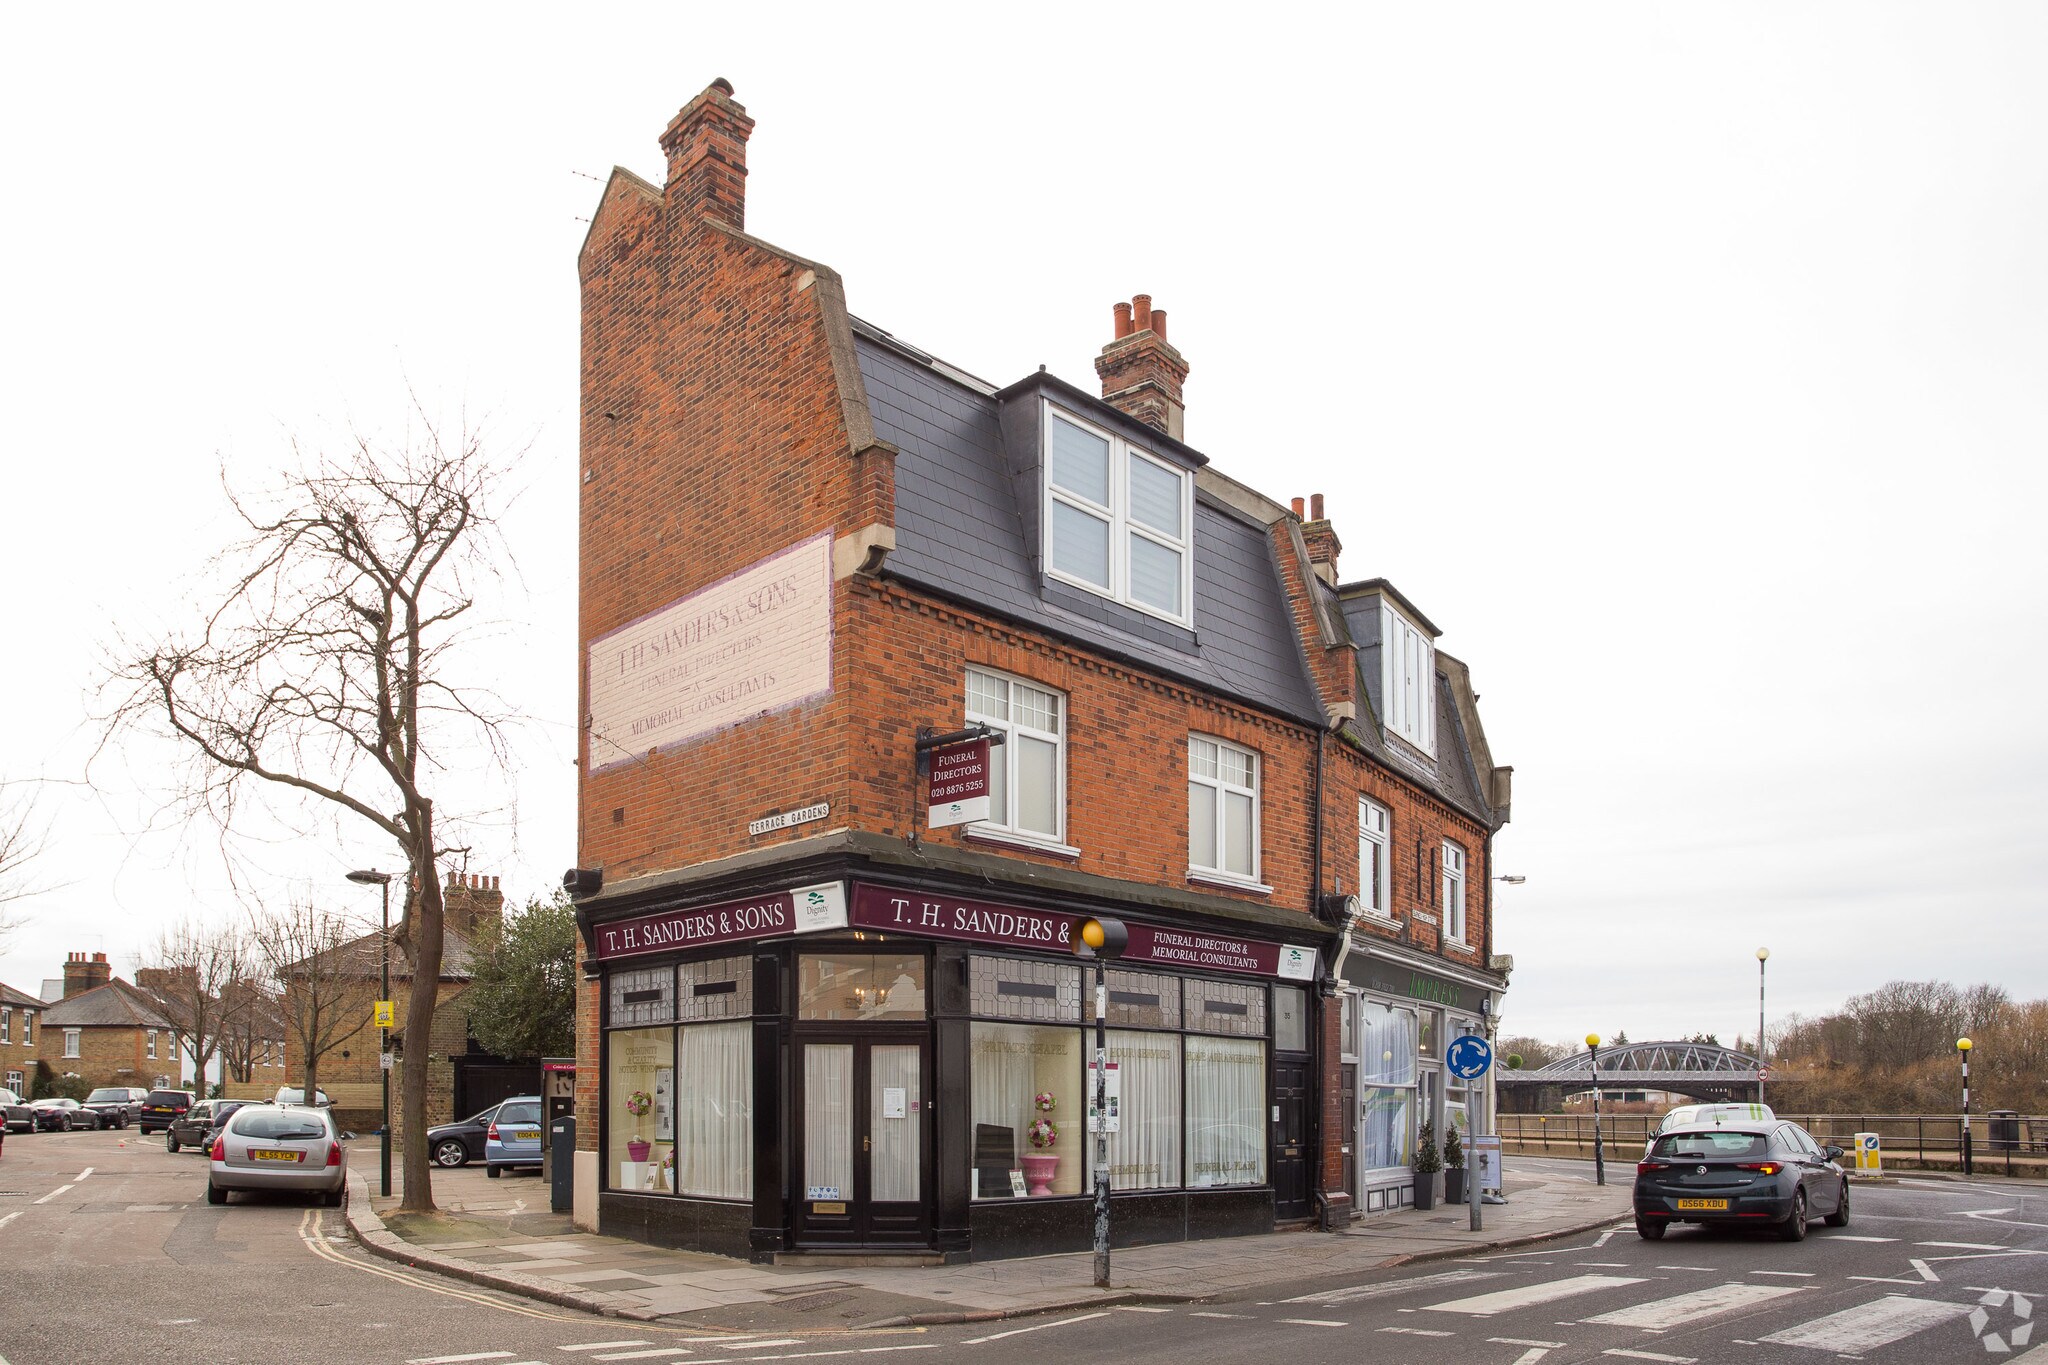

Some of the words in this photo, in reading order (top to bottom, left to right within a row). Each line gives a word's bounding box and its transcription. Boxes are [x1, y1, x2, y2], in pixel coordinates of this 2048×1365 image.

[651, 605, 729, 659] SANDERS
[747, 574, 797, 621] SONS
[695, 635, 762, 673] DIRECTORS
[631, 704, 683, 736] MEMORIAL
[691, 671, 776, 714] CONSULTANTS
[938, 750, 977, 767] FUNERAL
[933, 764, 982, 782] DIRECTORS
[931, 787, 945, 797] 020
[946, 783, 964, 795] 8876
[965, 780, 984, 791] 5255
[750, 815, 785, 833] TERRACE
[791, 805, 828, 823] GARDENS
[806, 905, 829, 916] Dignity
[890, 898, 912, 924] T.
[919, 902, 946, 928] H.
[953, 907, 1054, 942] SANDERS
[1057, 921, 1070, 944] &
[605, 931, 622, 952] T.
[624, 928, 641, 949] H.
[643, 913, 715, 946] SANDERS
[719, 912, 733, 935] &
[735, 902, 785, 932] SONS
[1153, 931, 1194, 948] FUNERAL
[1195, 938, 1241, 954] DIRECTORS
[1241, 944, 1248, 955] &
[1151, 946, 1199, 962] MEMORIAL
[1200, 952, 1258, 969] CONSULTANTS
[1407, 972, 1460, 1007] IMPRESS
[984, 1041, 1026, 1053] PRIVATE
[1029, 1043, 1068, 1055] CHAPEL
[1110, 1047, 1134, 1058] HOUR
[1137, 1048, 1171, 1060] SERVICE
[1109, 1163, 1160, 1175] MEMORIALS
[1194, 1162, 1232, 1173] FUNERAL
[1234, 1160, 1257, 1171] PLANS
[1682, 1199, 1705, 1208] DS66
